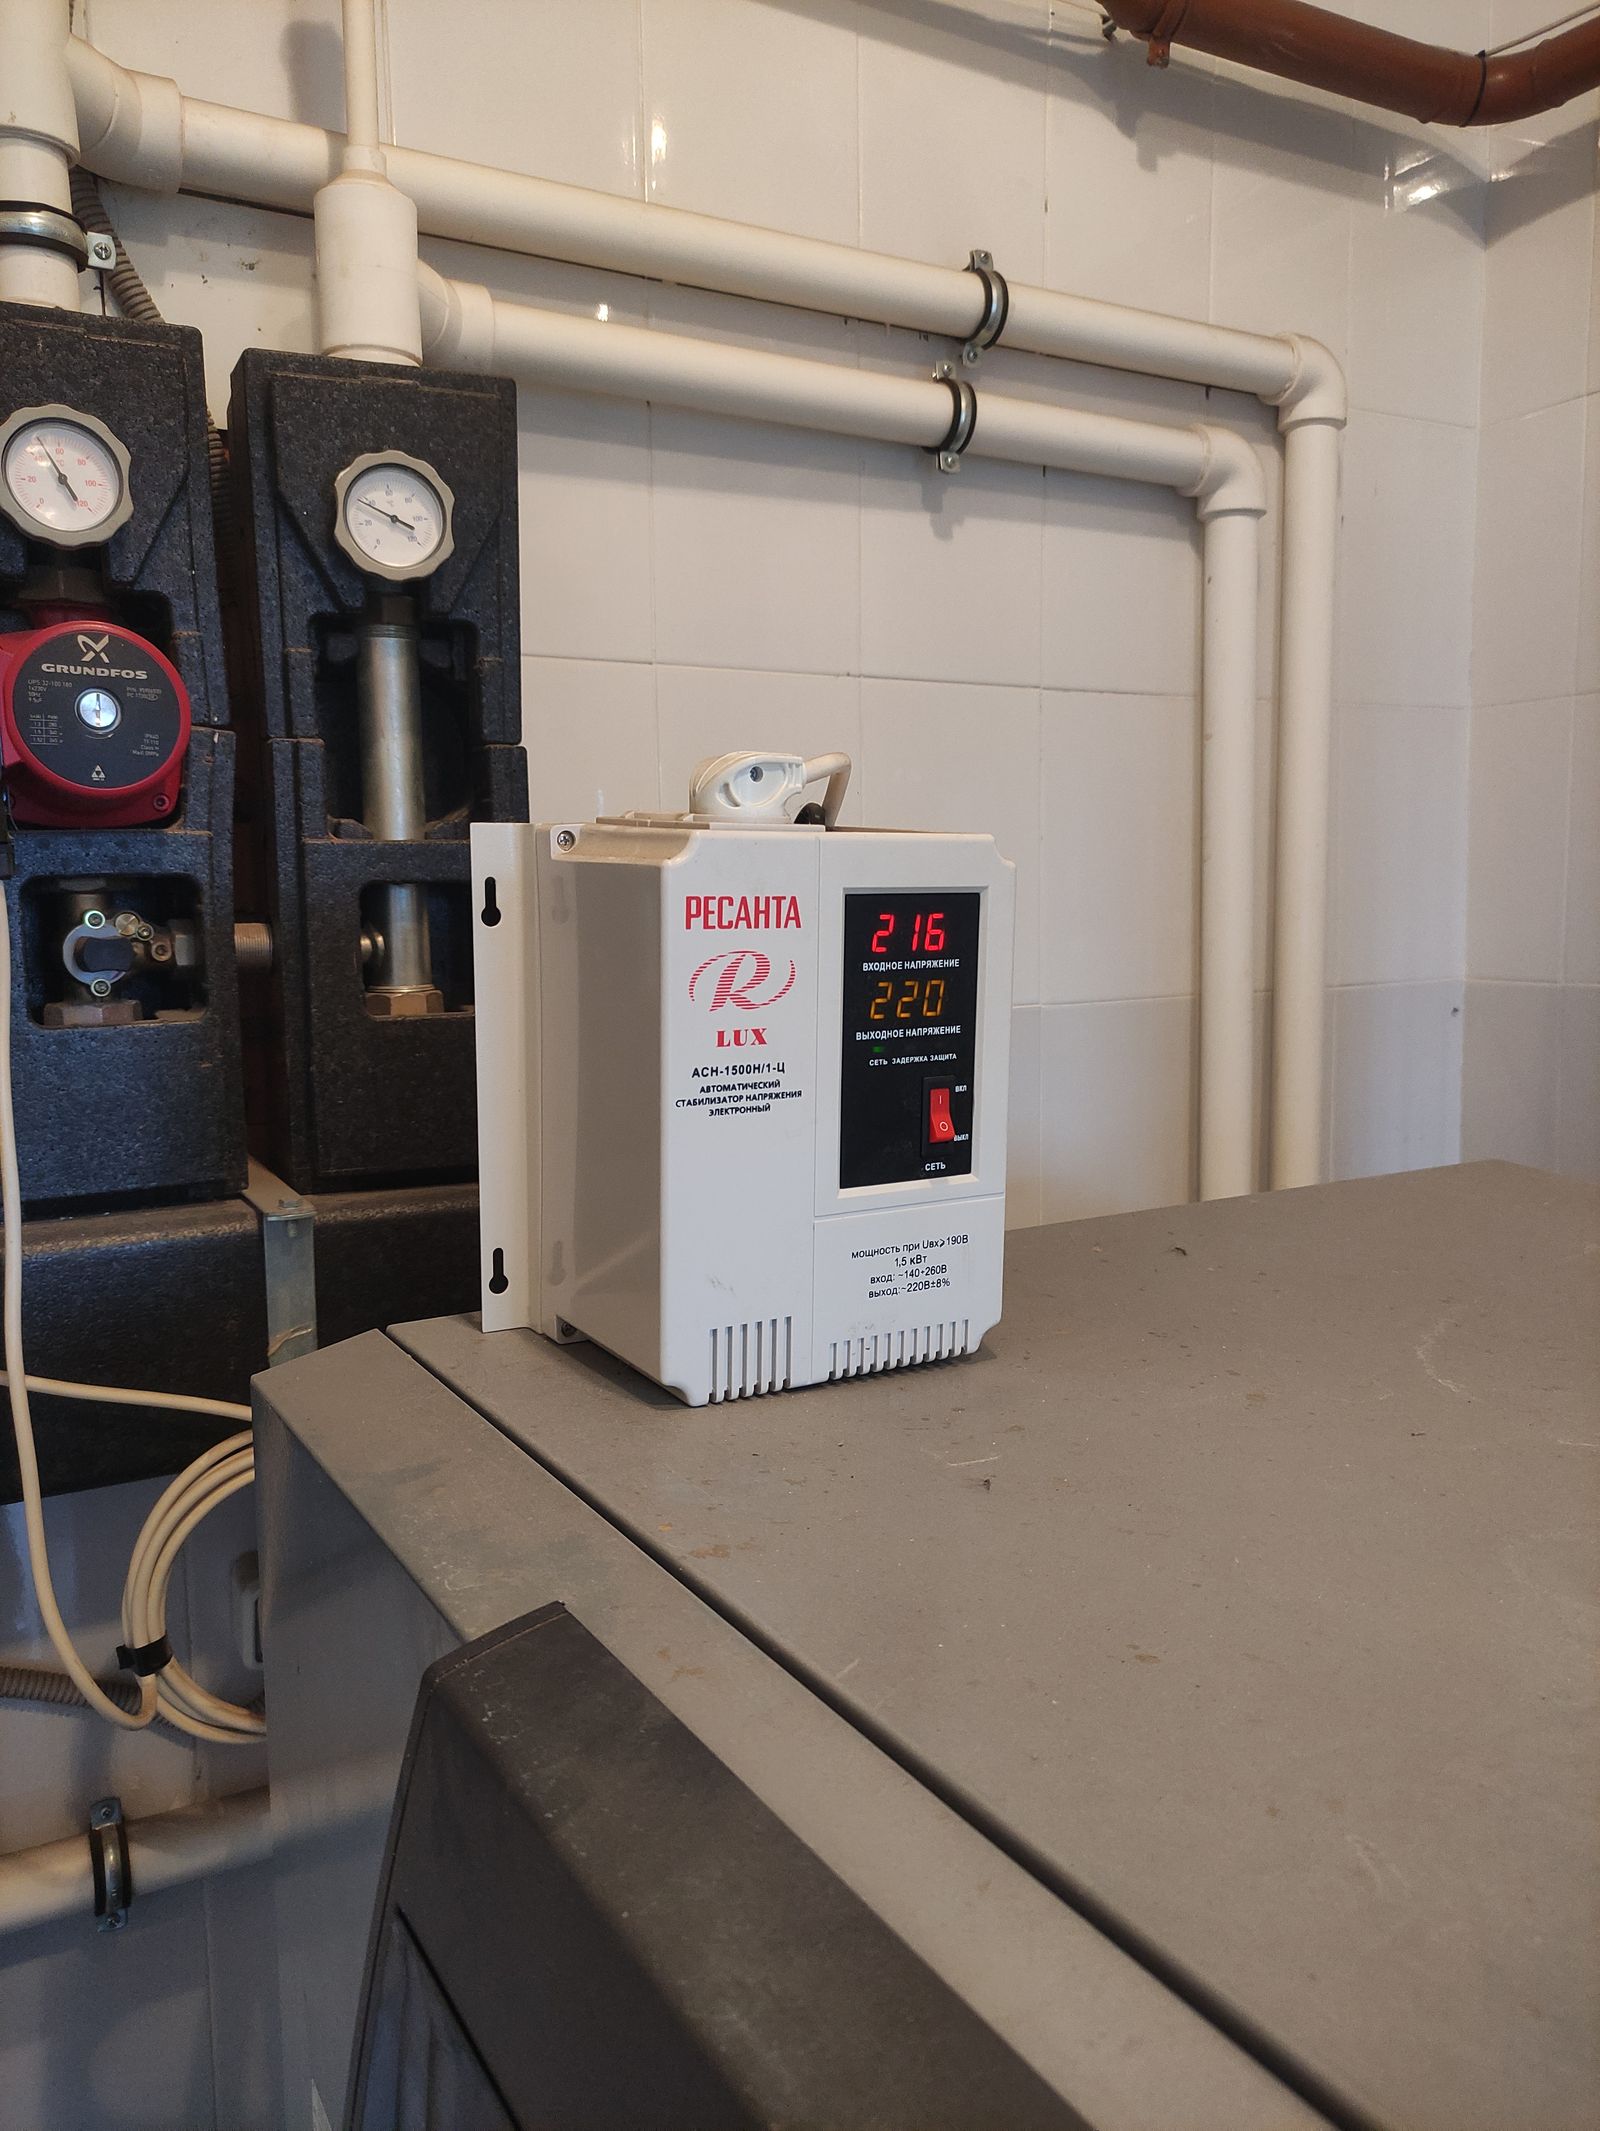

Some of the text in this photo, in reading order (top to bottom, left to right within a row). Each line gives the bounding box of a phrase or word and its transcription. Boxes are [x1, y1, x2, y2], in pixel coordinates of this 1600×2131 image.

[41, 663, 148, 680] GRUNDFOS
[685, 896, 801, 930] РЕСАНТА
[871, 913, 945, 952] 216
[863, 959, 960, 972] ВХОДНОЕ НАПРЯЖЕНИЕ
[870, 980, 945, 1019] 220
[716, 1028, 767, 1047] LUX
[856, 1025, 961, 1041] ВЫХОДНОЕ НАПРЯЖЕНИЕ
[892, 1055, 928, 1064] ЗАДЕРЖКА
[929, 1053, 957, 1061] ЗАЩИТА
[692, 1062, 785, 1078] АСН-1500Н/1-Ц
[700, 1079, 780, 1093] АВТОМАТИЧЕСКИЙ
[675, 1090, 802, 1108] СТАБИЛИЗАТОР НАПРЯЖЕНИЯ
[709, 1103, 771, 1117] ЭЛЕКТРОННЫЙ
[925, 1162, 946, 1171] СЕТЬ
[851, 1245, 900, 1259] мощность
[902, 1242, 920, 1253] при
[895, 1254, 927, 1268] 1,5 кВт
[870, 1273, 896, 1284] вход:
